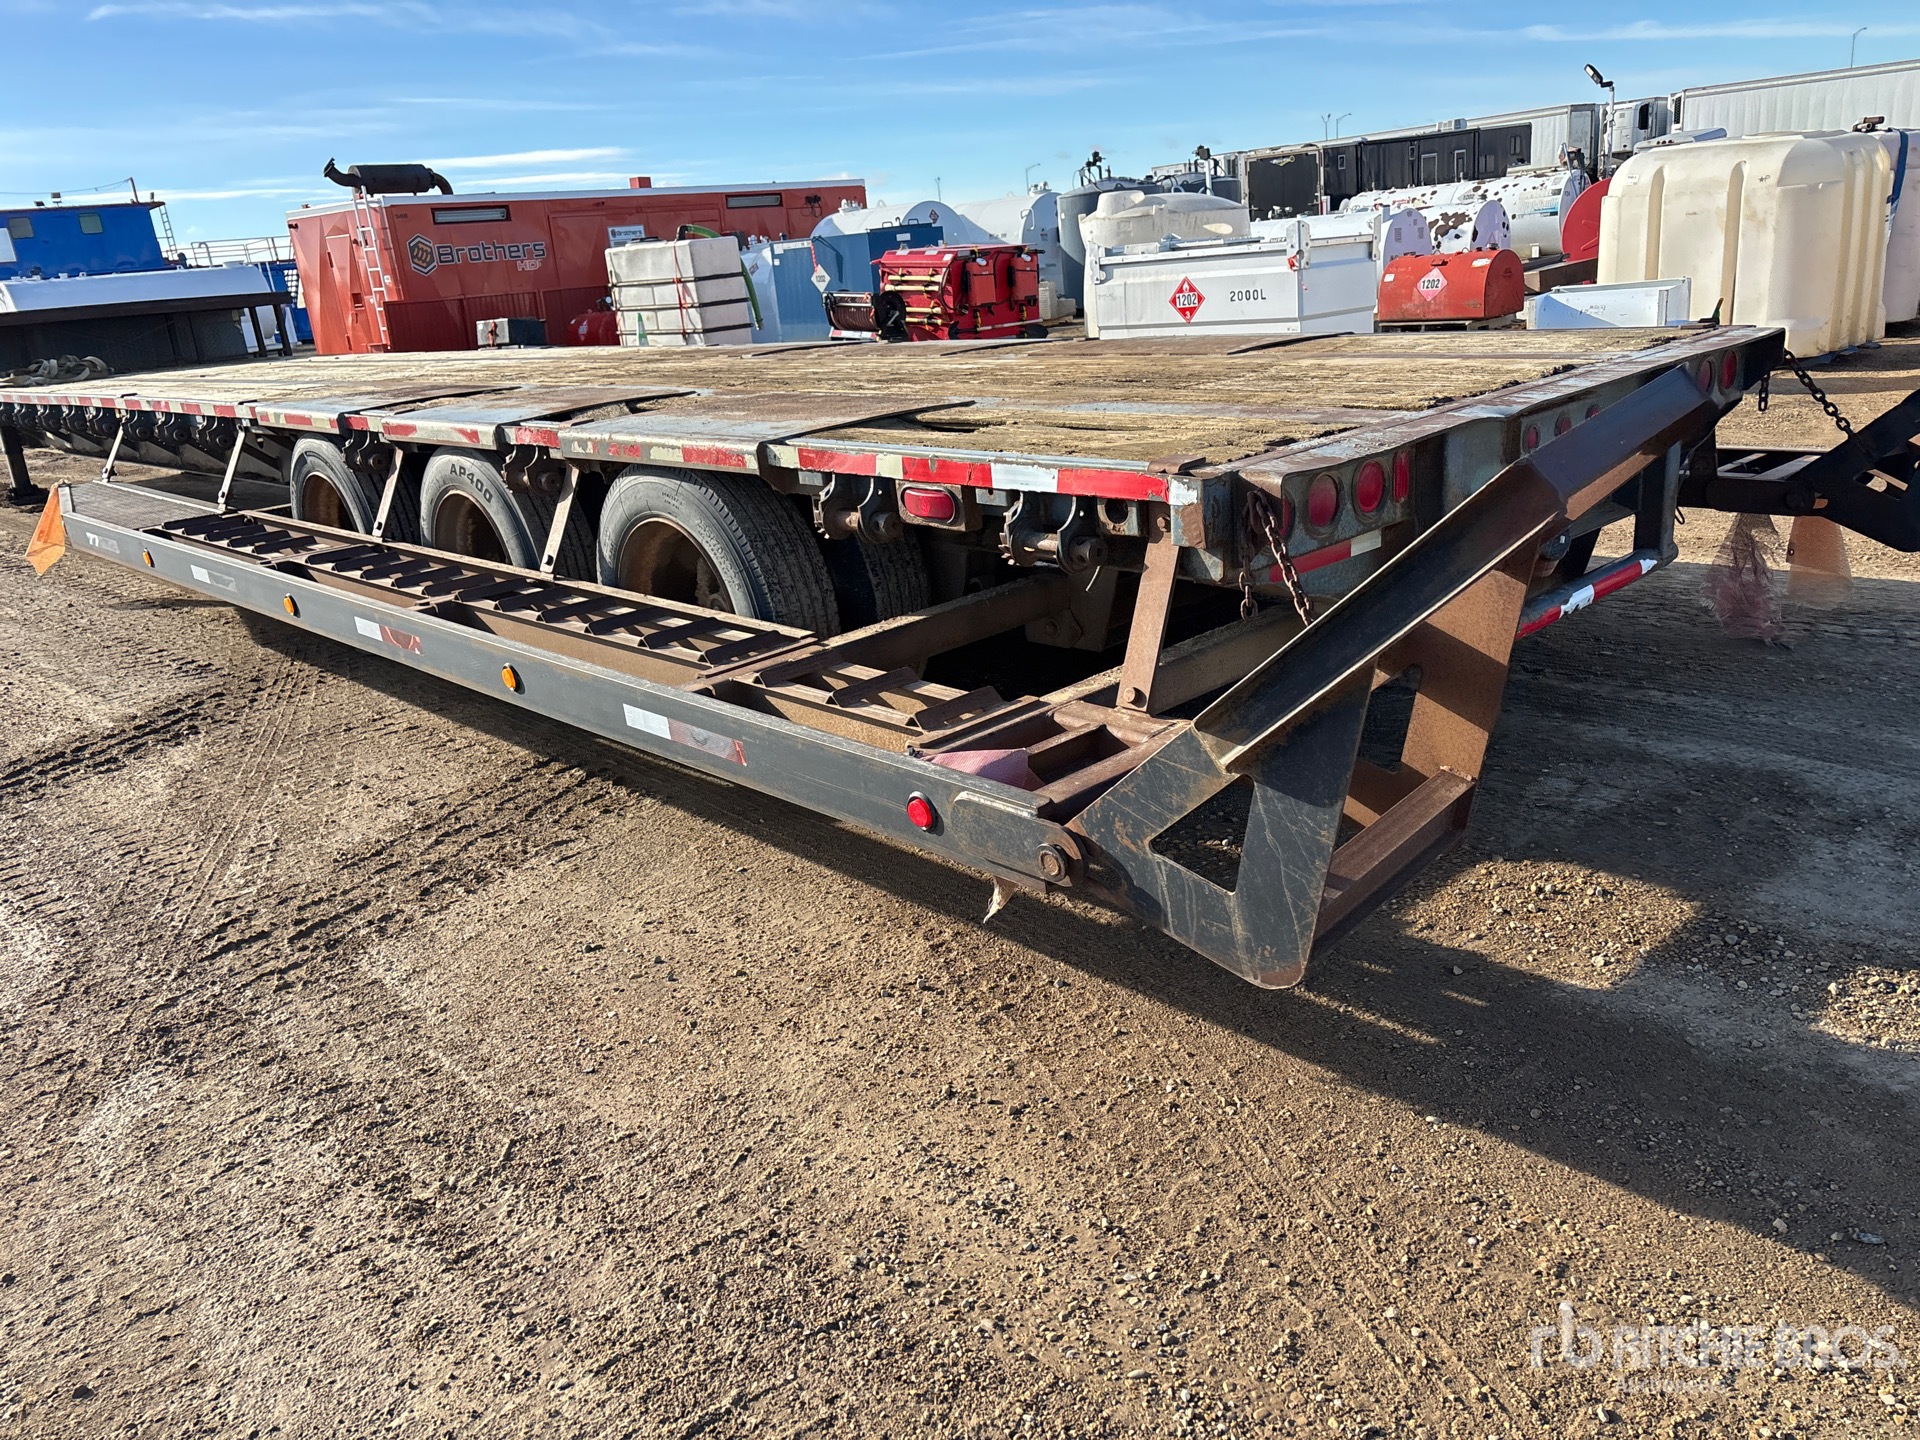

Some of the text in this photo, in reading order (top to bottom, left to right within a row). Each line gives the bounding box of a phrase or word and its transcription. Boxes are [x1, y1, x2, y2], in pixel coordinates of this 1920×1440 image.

[435, 240, 547, 265] Brothers
[1421, 279, 1441, 290] 1202
[1177, 293, 1198, 307] 1202
[1229, 288, 1267, 302] 2000L
[1185, 310, 1191, 319] 3
[449, 463, 493, 504] AP400
